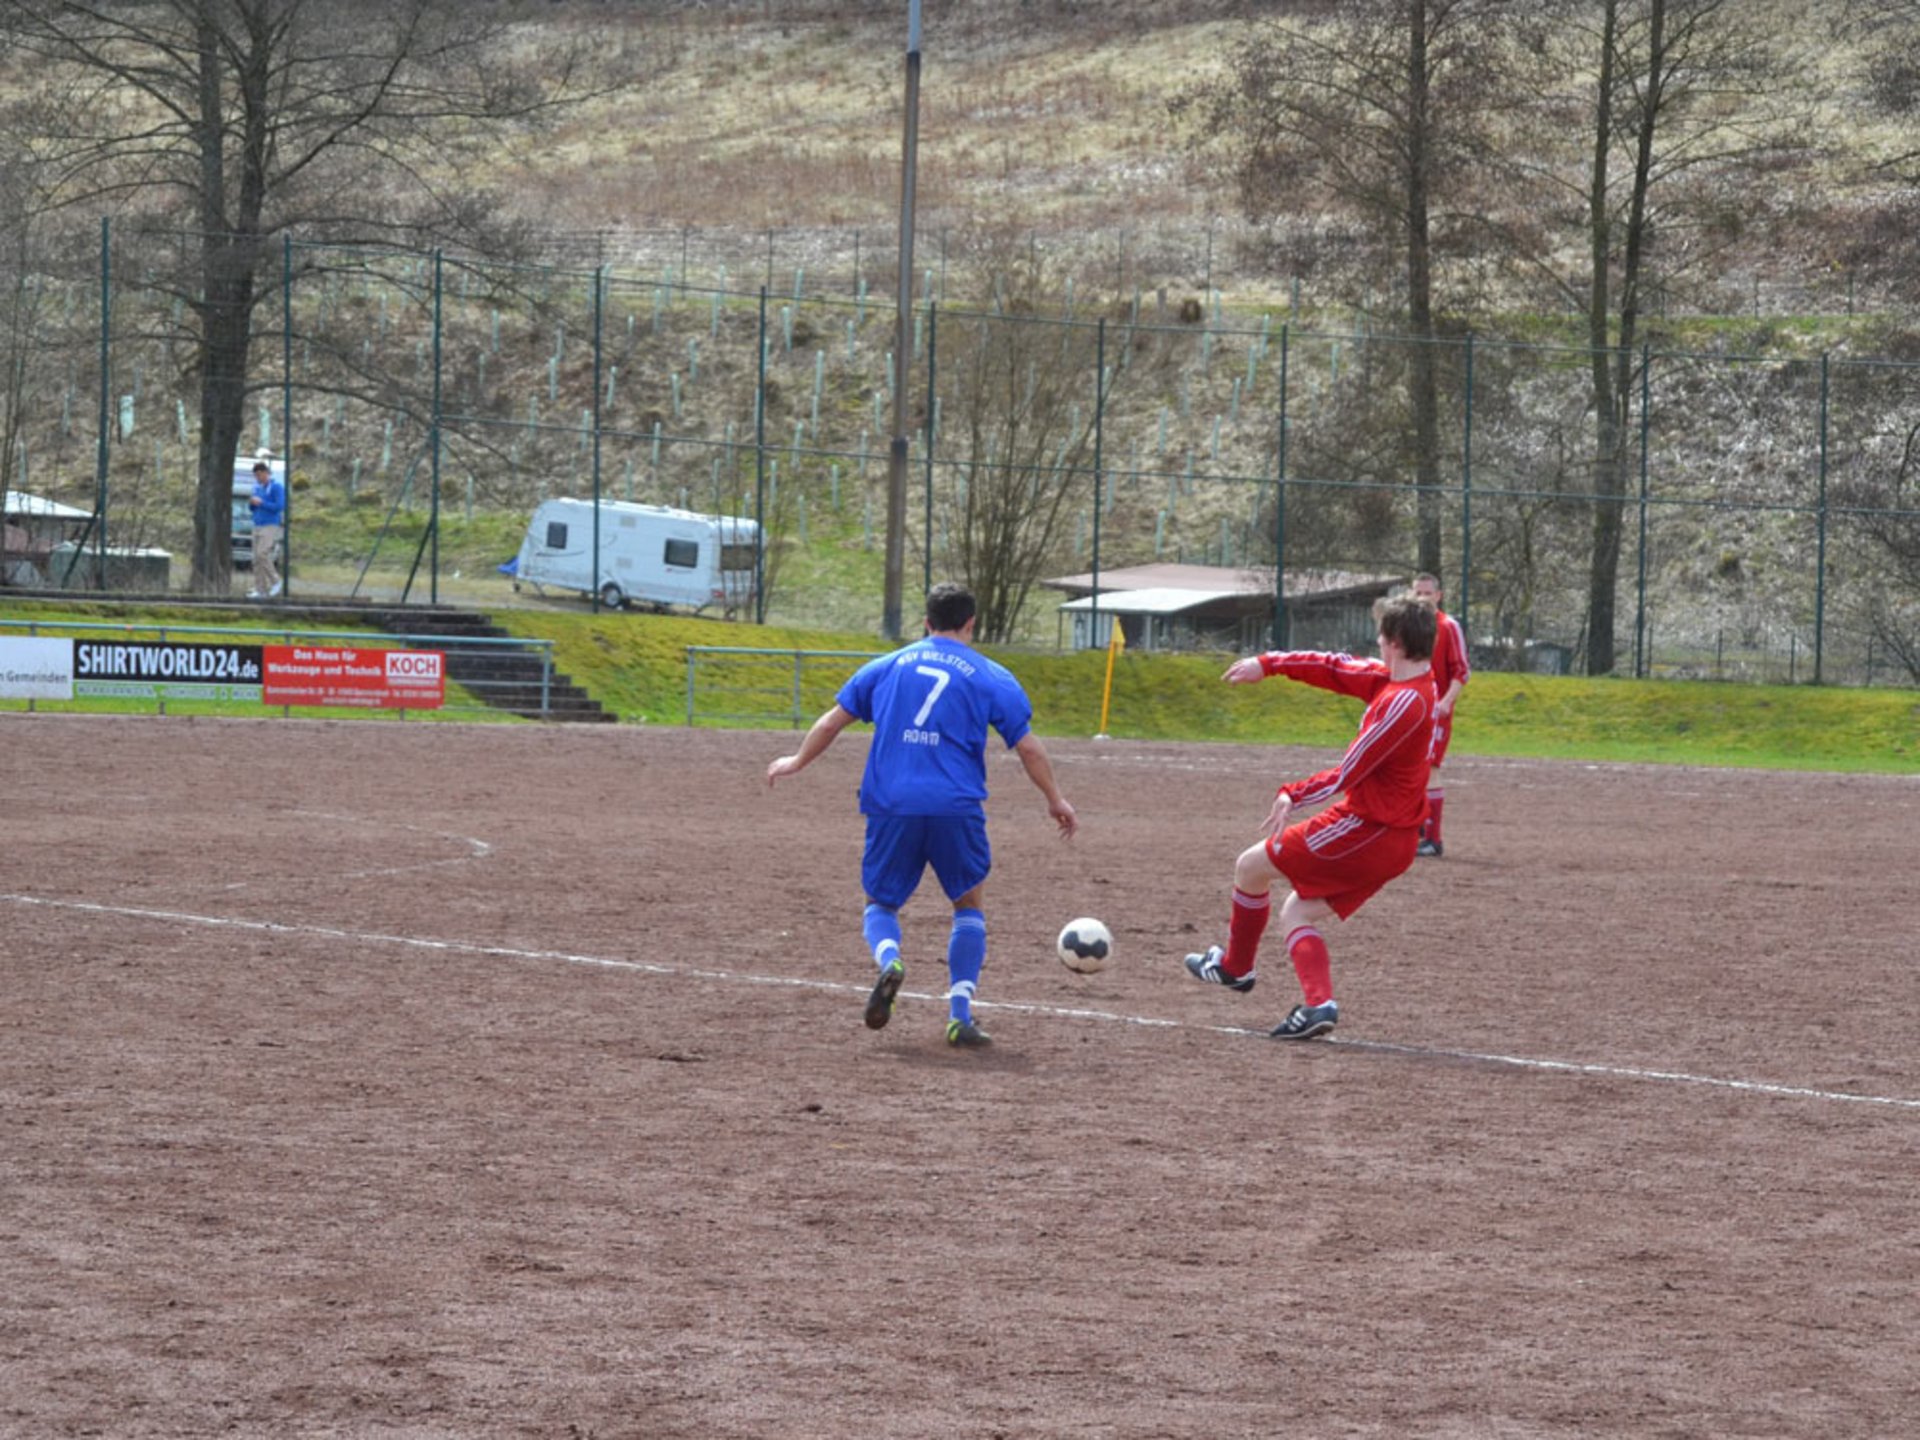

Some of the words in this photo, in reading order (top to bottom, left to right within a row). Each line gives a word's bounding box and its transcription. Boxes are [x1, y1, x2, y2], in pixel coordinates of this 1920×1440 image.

[78, 644, 258, 678] SHIRTWORLD24.de
[293, 650, 312, 660] Das
[315, 650, 338, 660] Haus
[343, 651, 356, 660] für
[268, 664, 319, 675] Werkzeuge
[324, 665, 342, 675] und
[346, 665, 381, 676] Technik
[389, 657, 437, 673] KOCH
[6, 669, 68, 684] Gemeinden
[914, 665, 951, 727] 7
[903, 729, 940, 745] ADAM
